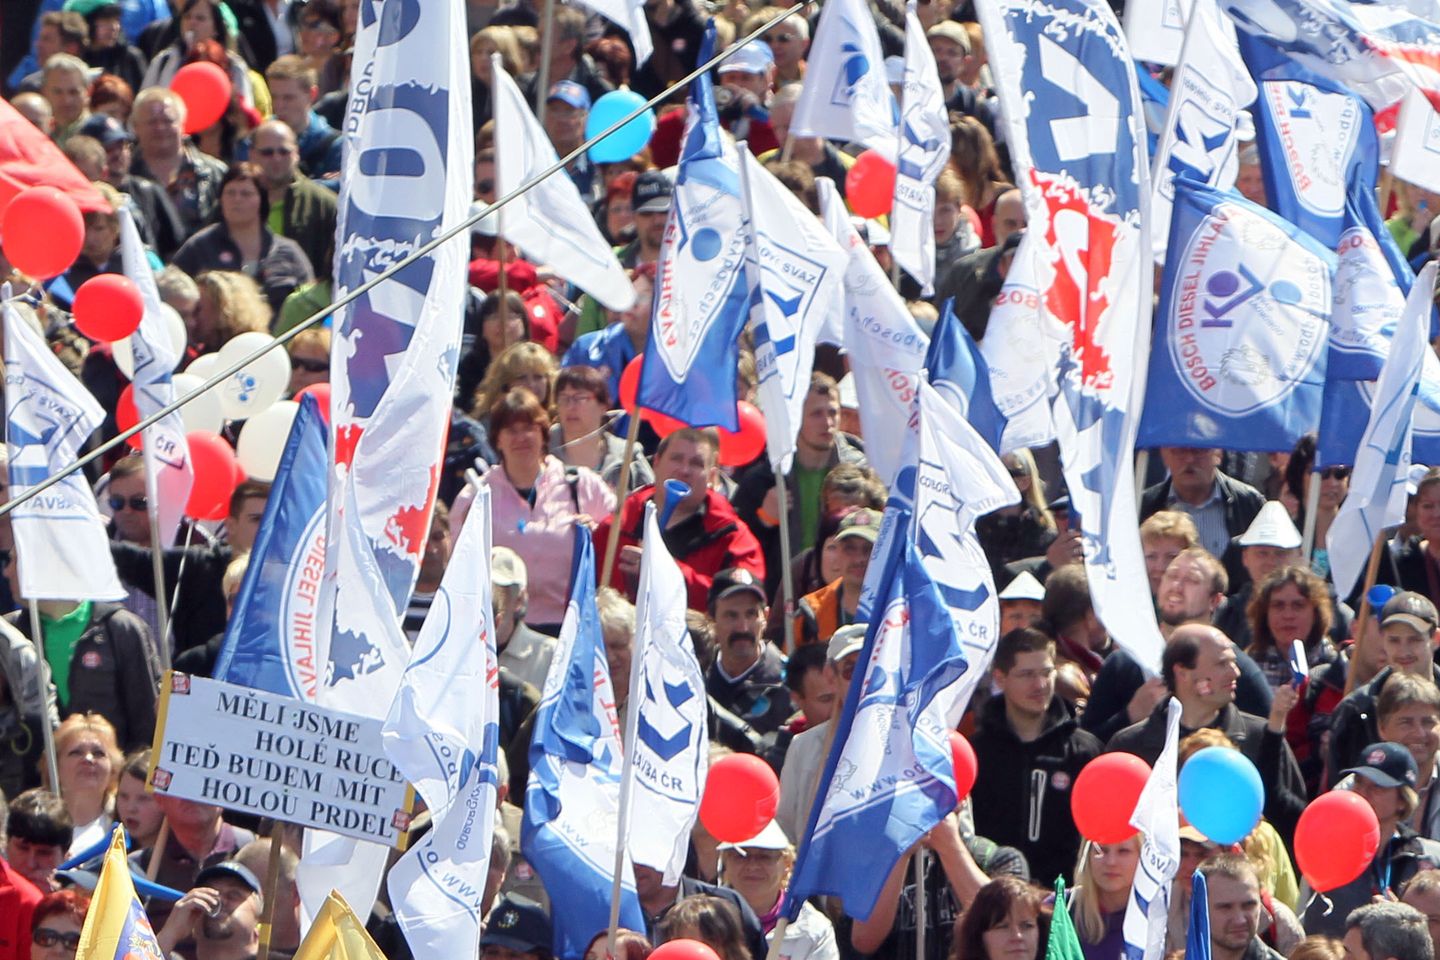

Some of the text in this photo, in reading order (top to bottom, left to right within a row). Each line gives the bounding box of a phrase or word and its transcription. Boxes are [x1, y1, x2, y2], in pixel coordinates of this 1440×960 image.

[1179, 271, 1200, 330] DIESEL
[1180, 335, 1217, 392] BOSCH
[216, 691, 361, 744] MĚLI JSME
[166, 741, 386, 806] TEĎ BUDEM MÍT
[256, 729, 329, 766] HOLÉ
[335, 752, 404, 784] RUCE
[200, 777, 298, 817] HOLOU
[310, 801, 395, 839] PRDEL
